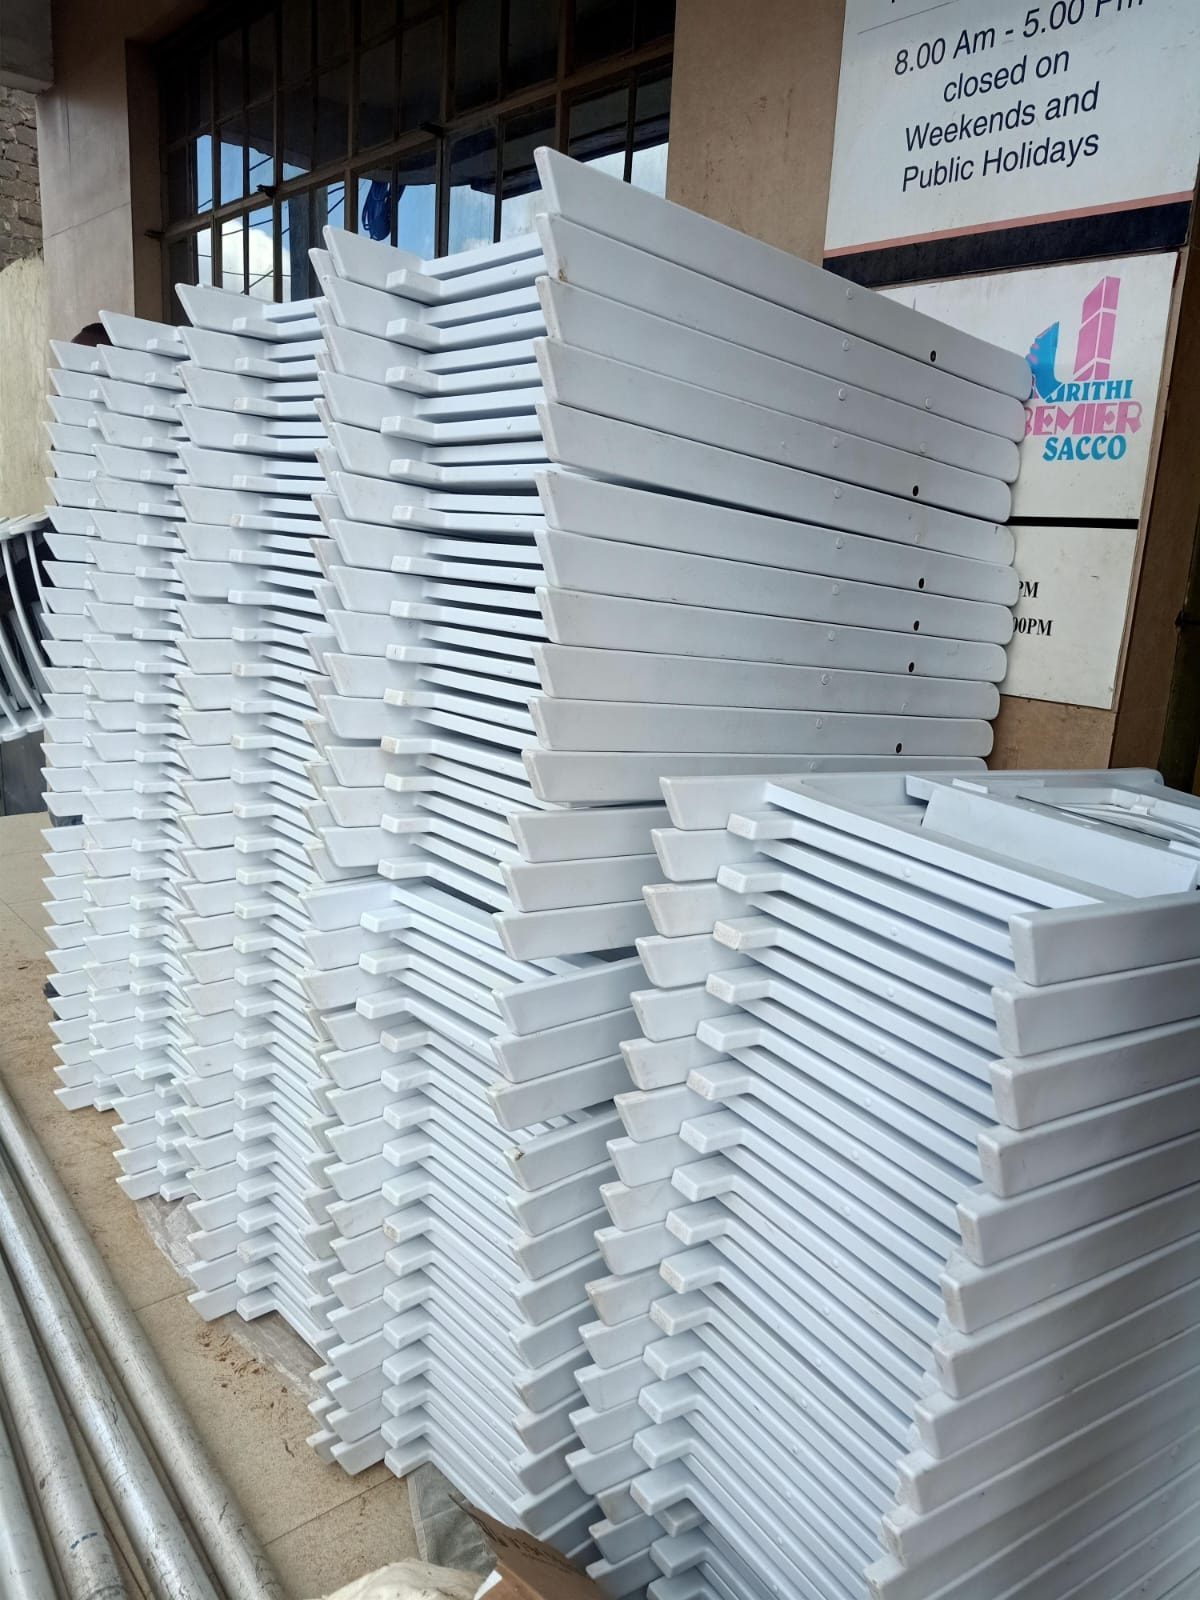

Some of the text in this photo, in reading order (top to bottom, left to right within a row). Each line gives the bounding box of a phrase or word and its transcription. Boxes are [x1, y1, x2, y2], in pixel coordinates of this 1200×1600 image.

[894, 37, 946, 76] 8.00
[952, 27, 996, 60] Am
[1022, 0, 1085, 38] 5.00
[943, 50, 1070, 103] closed on
[905, 80, 1100, 152] Weekends and
[902, 133, 1100, 193] Public Holidays
[1042, 434, 1127, 461] SACCO
